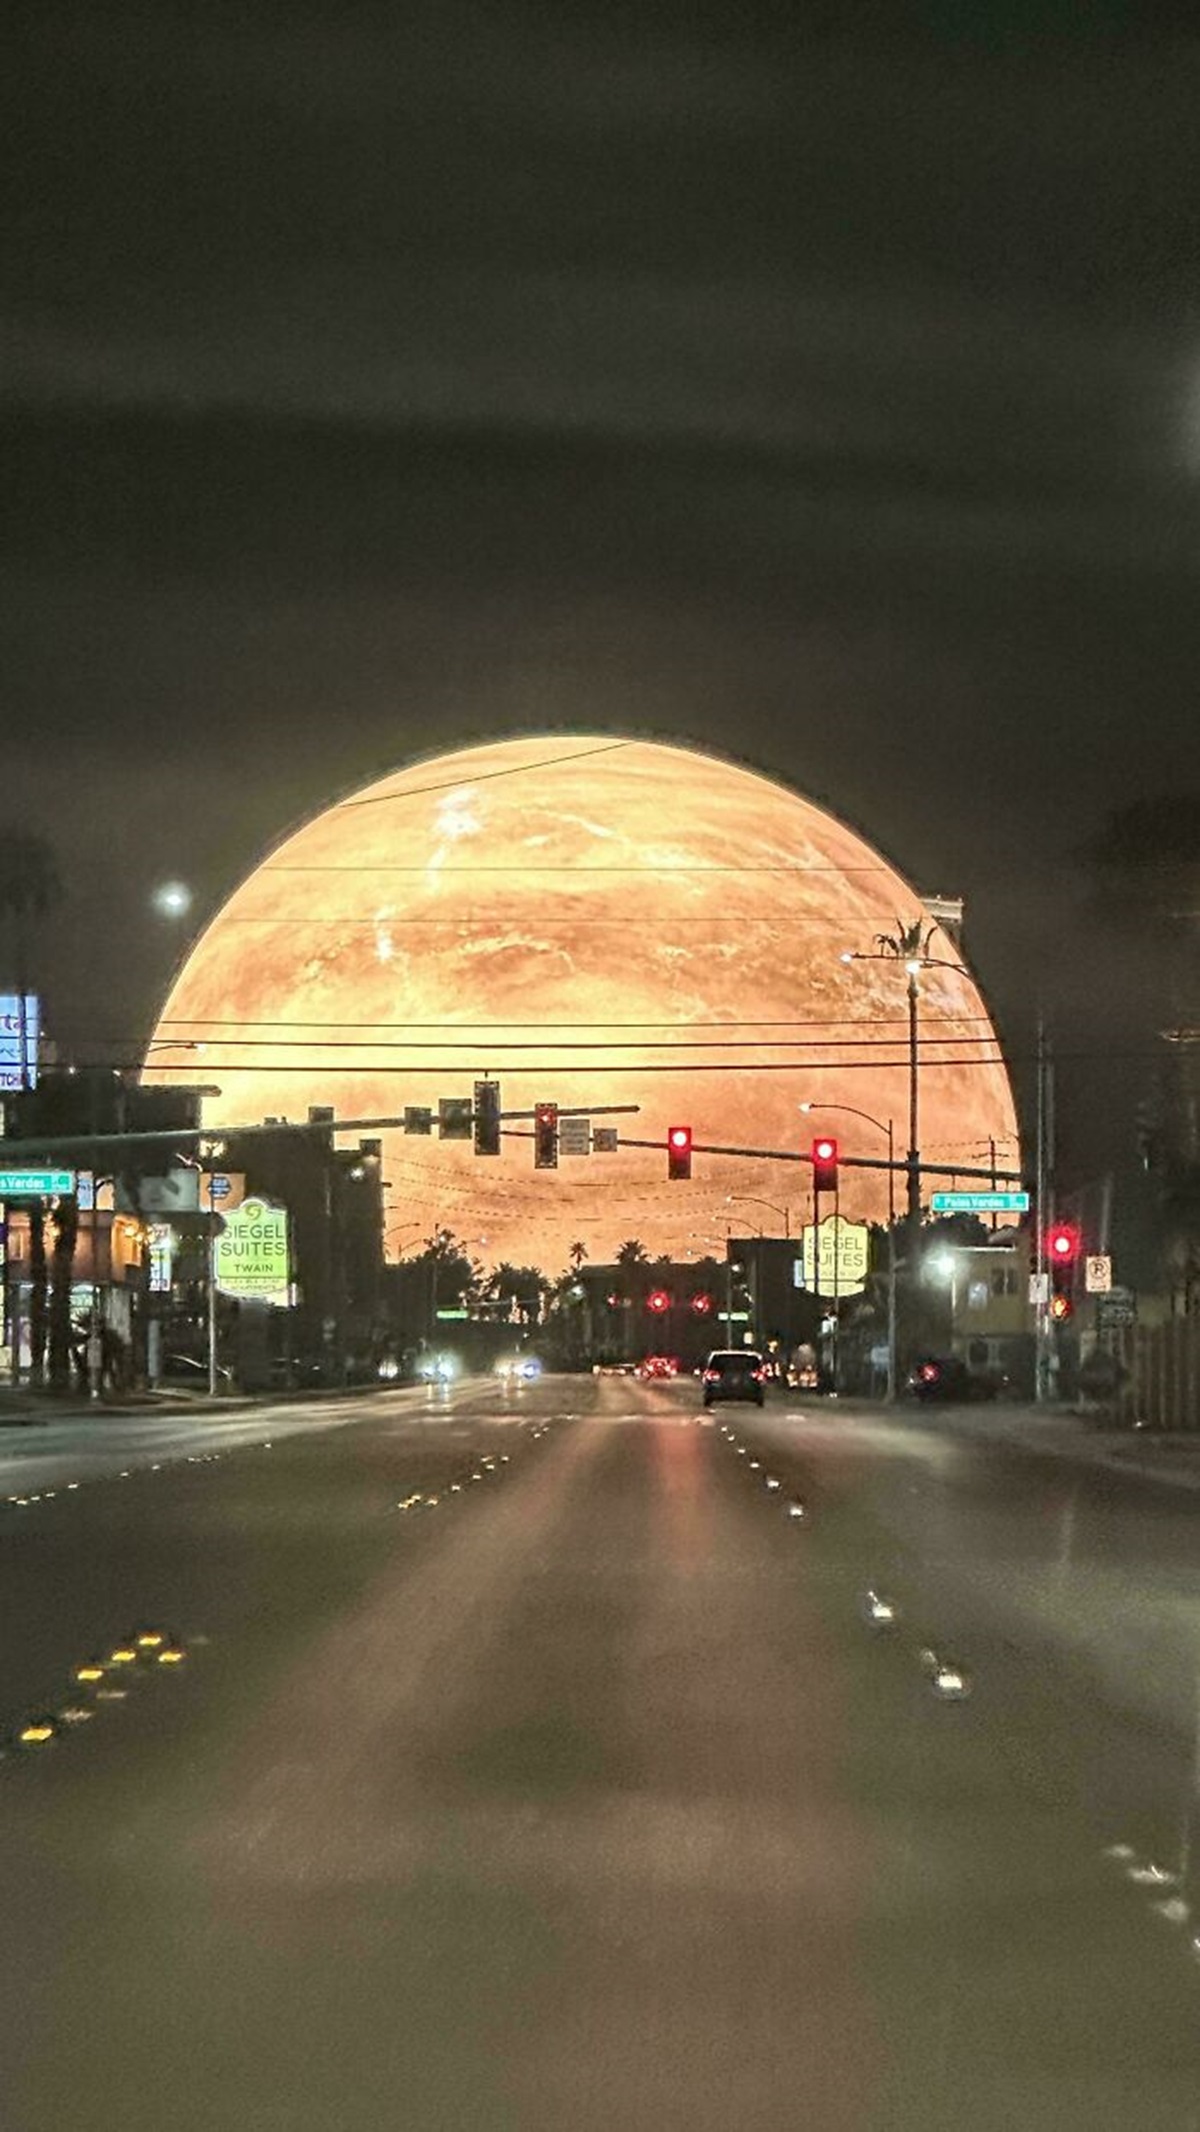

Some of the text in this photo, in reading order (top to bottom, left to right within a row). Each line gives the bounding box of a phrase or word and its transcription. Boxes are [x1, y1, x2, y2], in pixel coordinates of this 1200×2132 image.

[7, 1176, 45, 1189] Verdes
[223, 1224, 284, 1240] SIEGEL
[220, 1241, 285, 1256] SUITES
[808, 1236, 863, 1250] SEGEL
[233, 1264, 273, 1272] TWAIN
